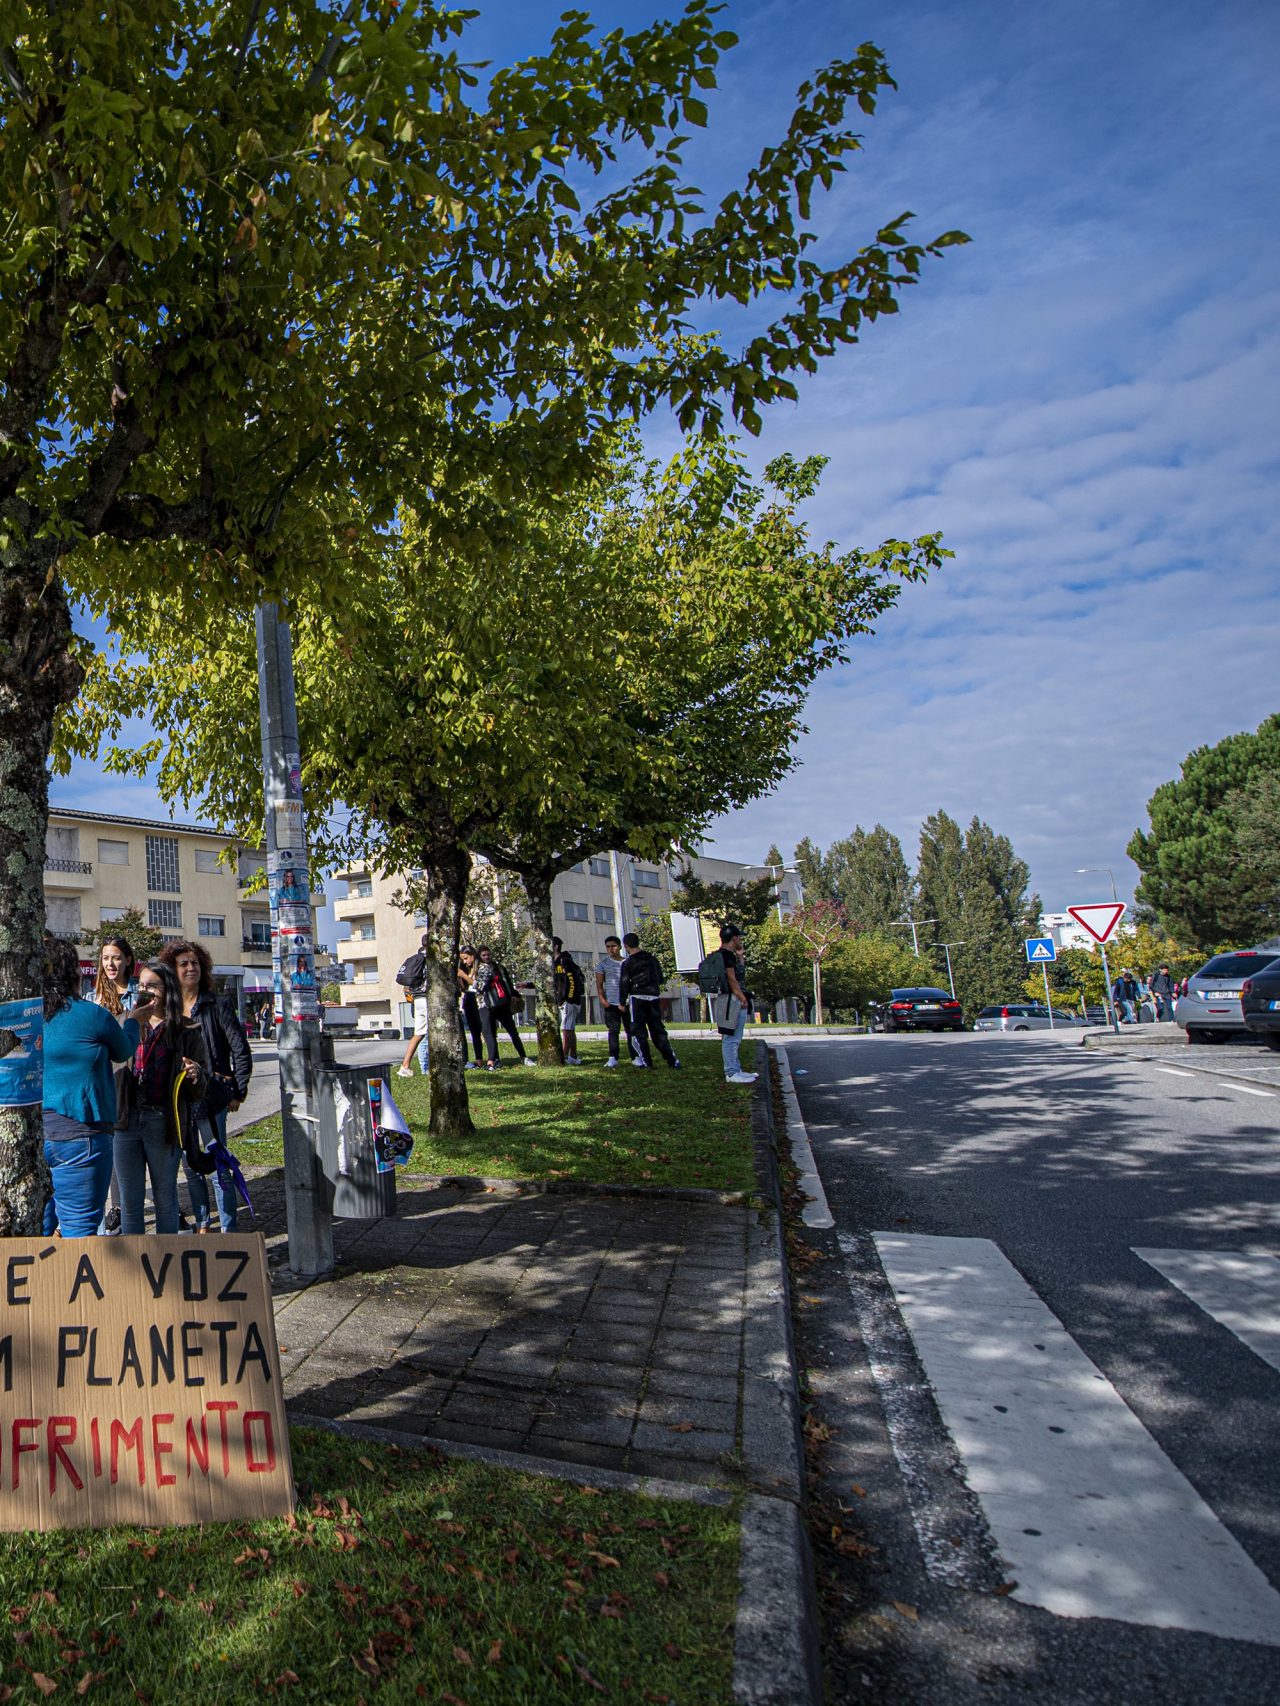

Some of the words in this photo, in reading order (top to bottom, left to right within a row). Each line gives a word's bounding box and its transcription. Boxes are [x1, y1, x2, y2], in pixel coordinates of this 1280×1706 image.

[68, 1253, 105, 1303] A
[140, 1250, 250, 1302] VOZ
[56, 1320, 272, 1388] PLANETA
